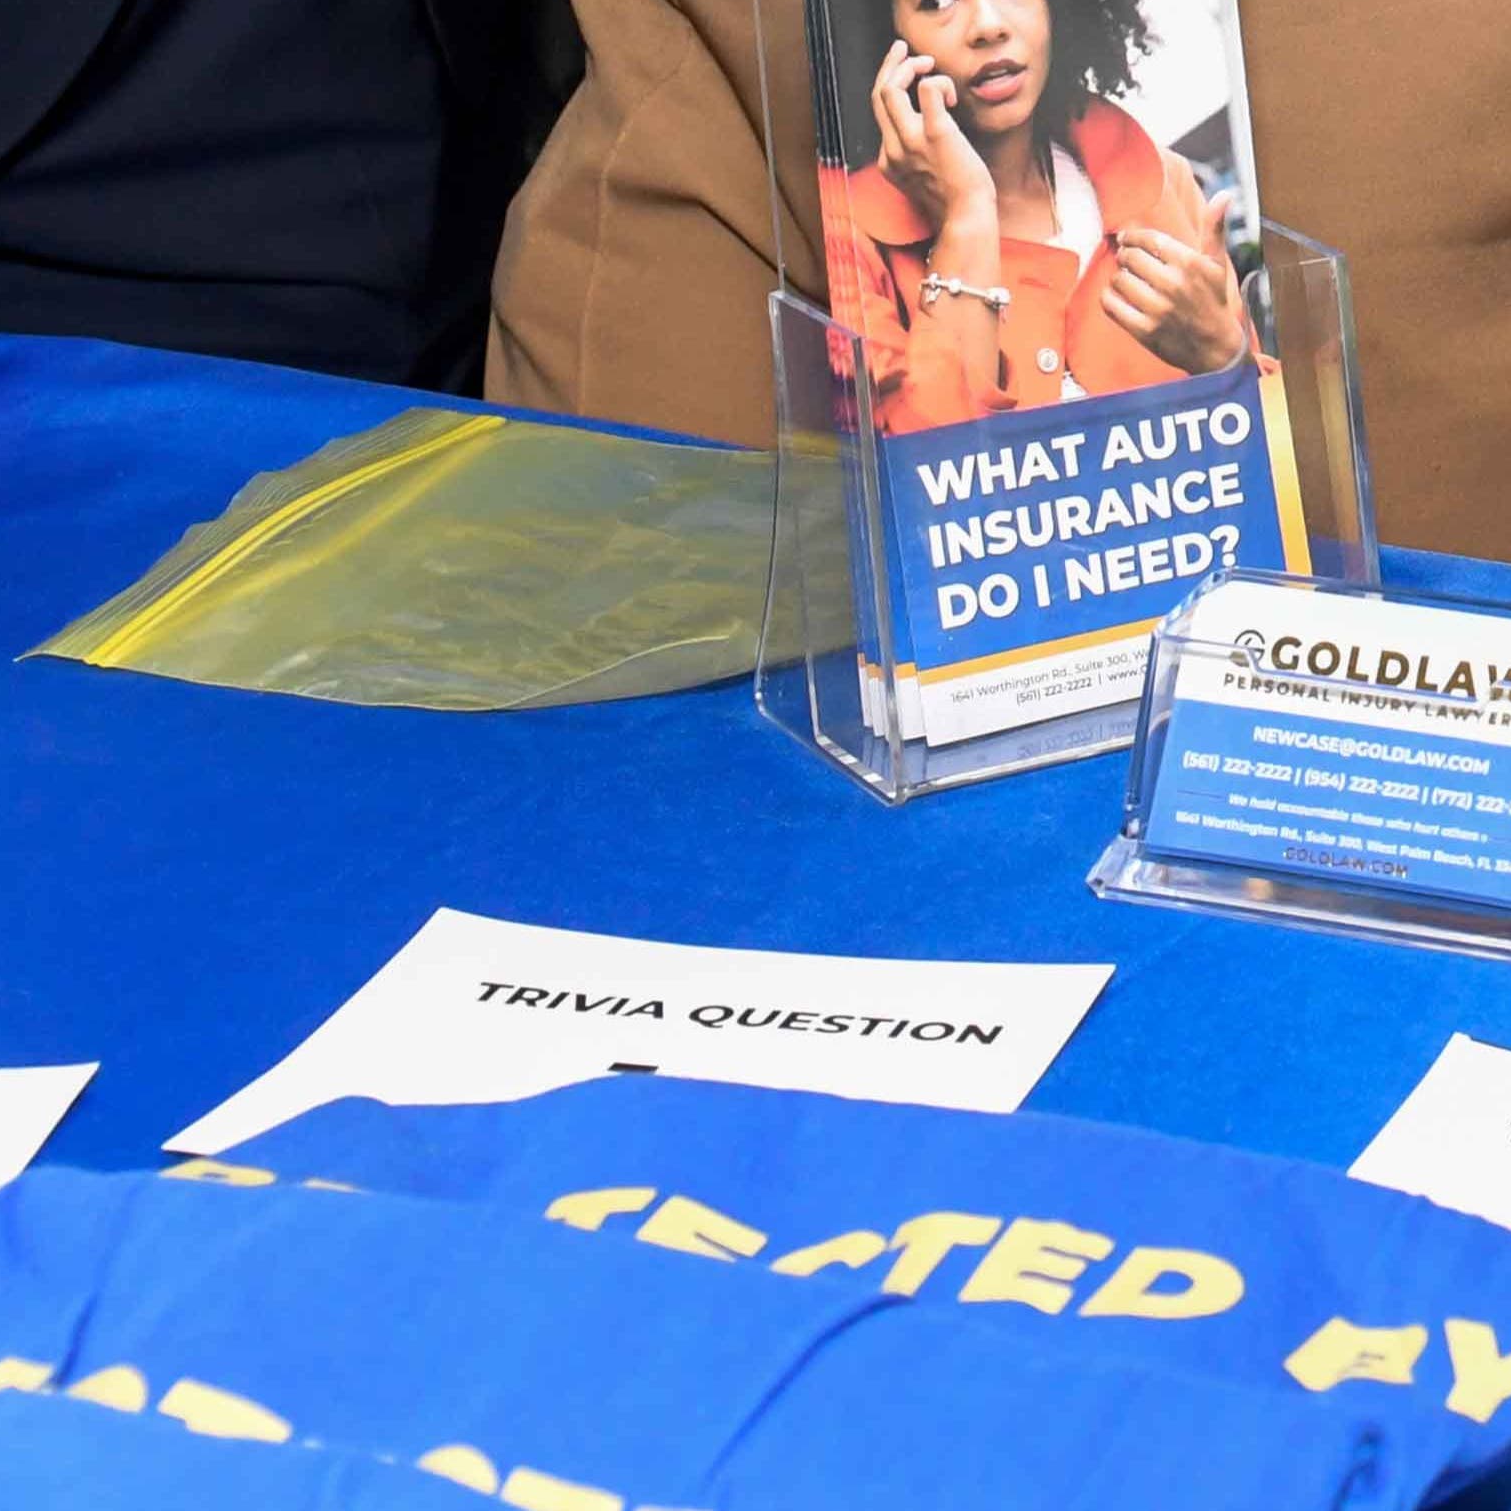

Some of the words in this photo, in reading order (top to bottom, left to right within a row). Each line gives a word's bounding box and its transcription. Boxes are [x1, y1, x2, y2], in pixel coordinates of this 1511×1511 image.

[917, 432, 1086, 507] WHAT
[1102, 402, 1252, 471] AUTO
[927, 463, 1245, 569] INSURANCE
[937, 575, 1019, 630] DO
[1034, 565, 1051, 607] I
[1067, 524, 1241, 601] NEED?
[1253, 725, 1490, 775] NEWCASE@GOLDLAW.COM
[478, 982, 664, 1019] TRIVIA
[689, 1002, 1004, 1047] QUESTION
